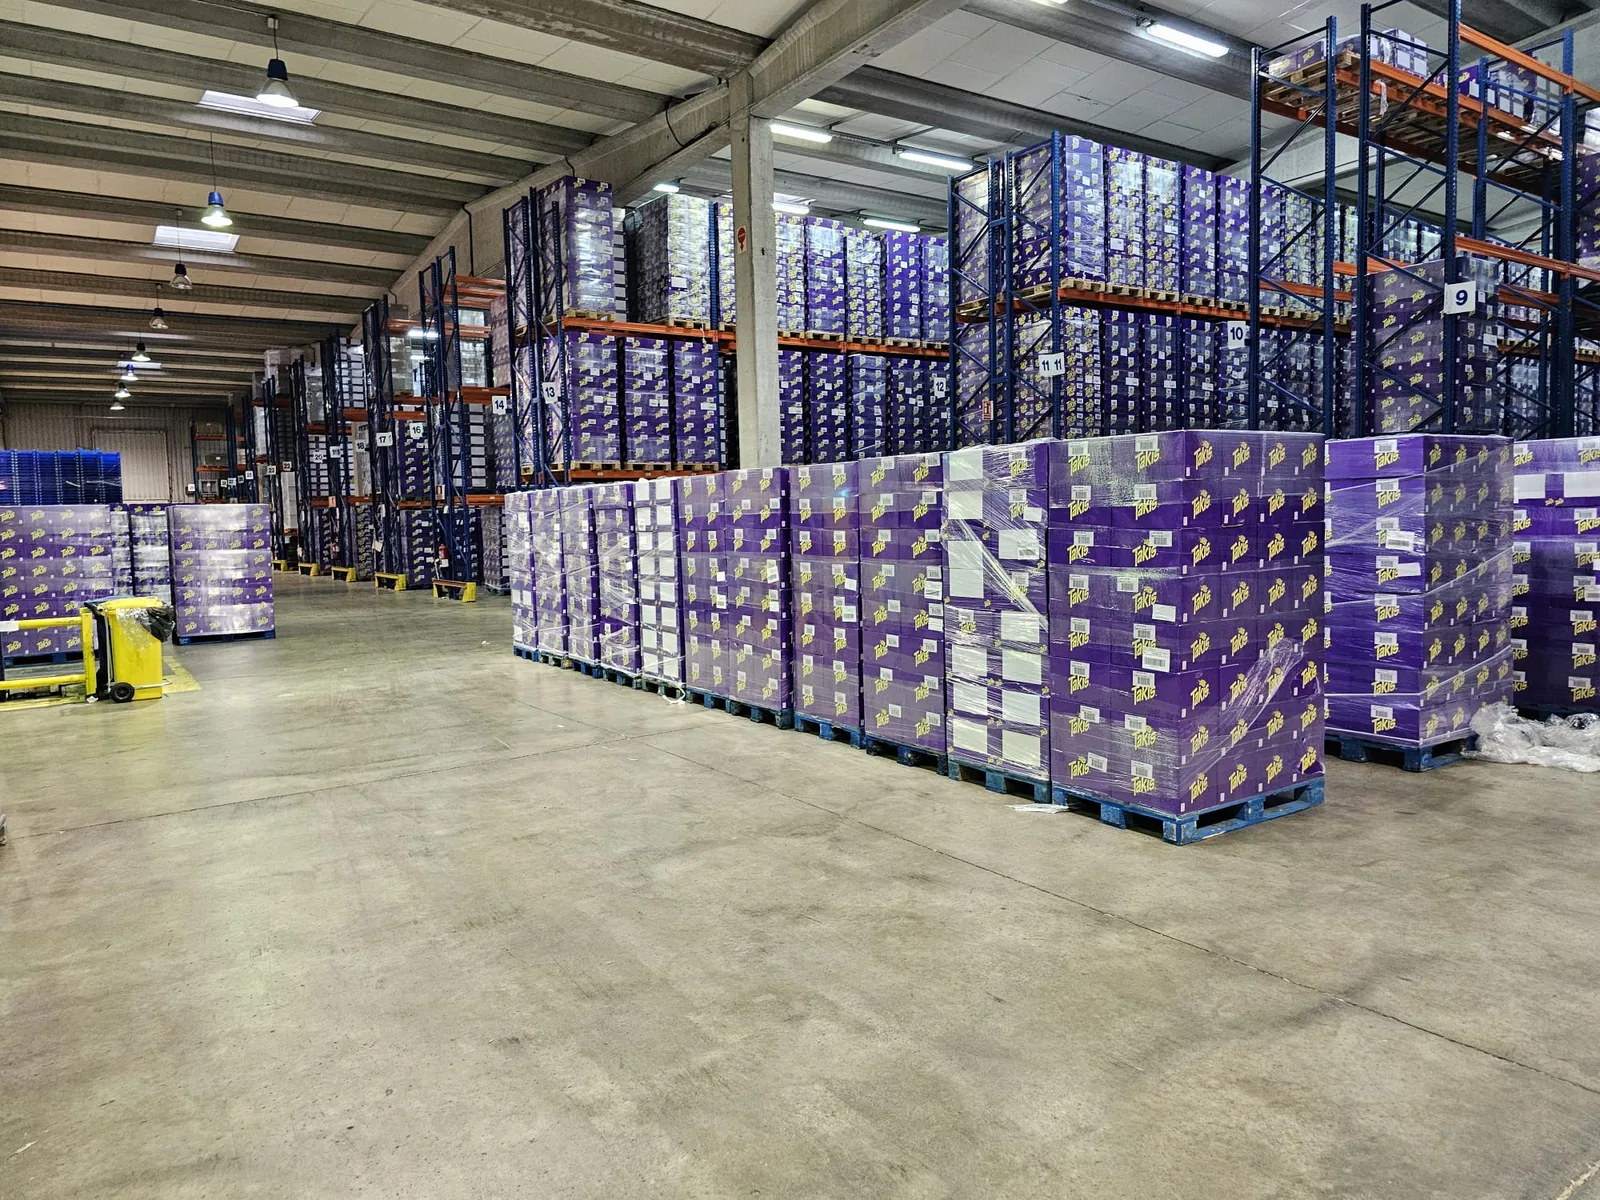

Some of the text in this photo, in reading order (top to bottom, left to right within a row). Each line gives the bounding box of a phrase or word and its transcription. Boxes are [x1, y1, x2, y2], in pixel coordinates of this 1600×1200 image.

[1455, 289, 1468, 306] 9
[1230, 326, 1243, 341] 10
[1041, 360, 1050, 371] 11
[1054, 358, 1062, 370] 11
[545, 387, 555, 398] 13
[936, 381, 944, 392] 12
[494, 400, 504, 410] 14
[412, 426, 421, 434] 16
[356, 442, 365, 450] 18
[1194, 440, 1213, 470] Takis
[1232, 441, 1250, 471] Takis
[1269, 442, 1286, 470] Takis
[1302, 442, 1317, 469] Takis
[1068, 454, 1090, 476] Takis
[1135, 448, 1160, 472] Takis
[1374, 451, 1399, 470] Takis
[1514, 452, 1533, 466] akis
[1068, 499, 1091, 520] Takis
[1134, 499, 1158, 520] Takis
[1192, 489, 1211, 519] Takis
[1232, 488, 1249, 517] Takis
[1268, 488, 1285, 516] Takis
[1301, 487, 1317, 513] Takis
[1376, 490, 1401, 509] Takis
[1513, 518, 1530, 531] akis
[1575, 518, 1600, 534] Takis
[1067, 545, 1088, 564] Takis
[1132, 539, 1158, 567] Takis
[1191, 536, 1211, 567] Takis
[1230, 534, 1249, 564] Takis
[1268, 533, 1285, 561] Takis
[1302, 531, 1318, 558] Takis
[1512, 552, 1530, 564] akis
[1068, 588, 1090, 608] Takis
[1132, 585, 1158, 613] Takis
[1192, 584, 1212, 615] Takis
[1231, 581, 1249, 610] Takis
[1268, 578, 1285, 606] Takis
[1302, 574, 1318, 602] Takis
[1512, 584, 1529, 596] akis
[1375, 605, 1400, 622] Takis
[1510, 616, 1528, 628] akis
[1267, 623, 1284, 649] Takis
[1301, 618, 1317, 645] Takis
[1572, 620, 1597, 635] Takis
[1068, 632, 1090, 650] Takis
[1191, 632, 1210, 662] Takis
[1230, 627, 1248, 657] Takis
[1374, 643, 1399, 660] Takis
[1572, 654, 1596, 669] Takis
[1068, 674, 1090, 695] Takis
[1267, 667, 1284, 695] Takis
[1301, 661, 1317, 688] Takis
[1131, 685, 1156, 705] Takis
[1190, 679, 1210, 710] Takis
[1230, 673, 1248, 702] Takis
[1371, 681, 1396, 697] Takis
[1571, 687, 1595, 702] Takis
[1069, 713, 1090, 737] Takis
[1266, 711, 1284, 739] Takis
[1301, 704, 1317, 731] Takis
[1371, 717, 1396, 734] Takis
[1132, 725, 1157, 750] Takis
[1190, 725, 1209, 756] Takis
[1229, 718, 1247, 747] Takis
[1069, 755, 1090, 779] Takis
[1266, 755, 1283, 784] Takis
[1300, 746, 1317, 774] Takis
[1131, 777, 1156, 796] Takis
[1189, 772, 1208, 803] Takis
[1229, 763, 1246, 793] Takis
